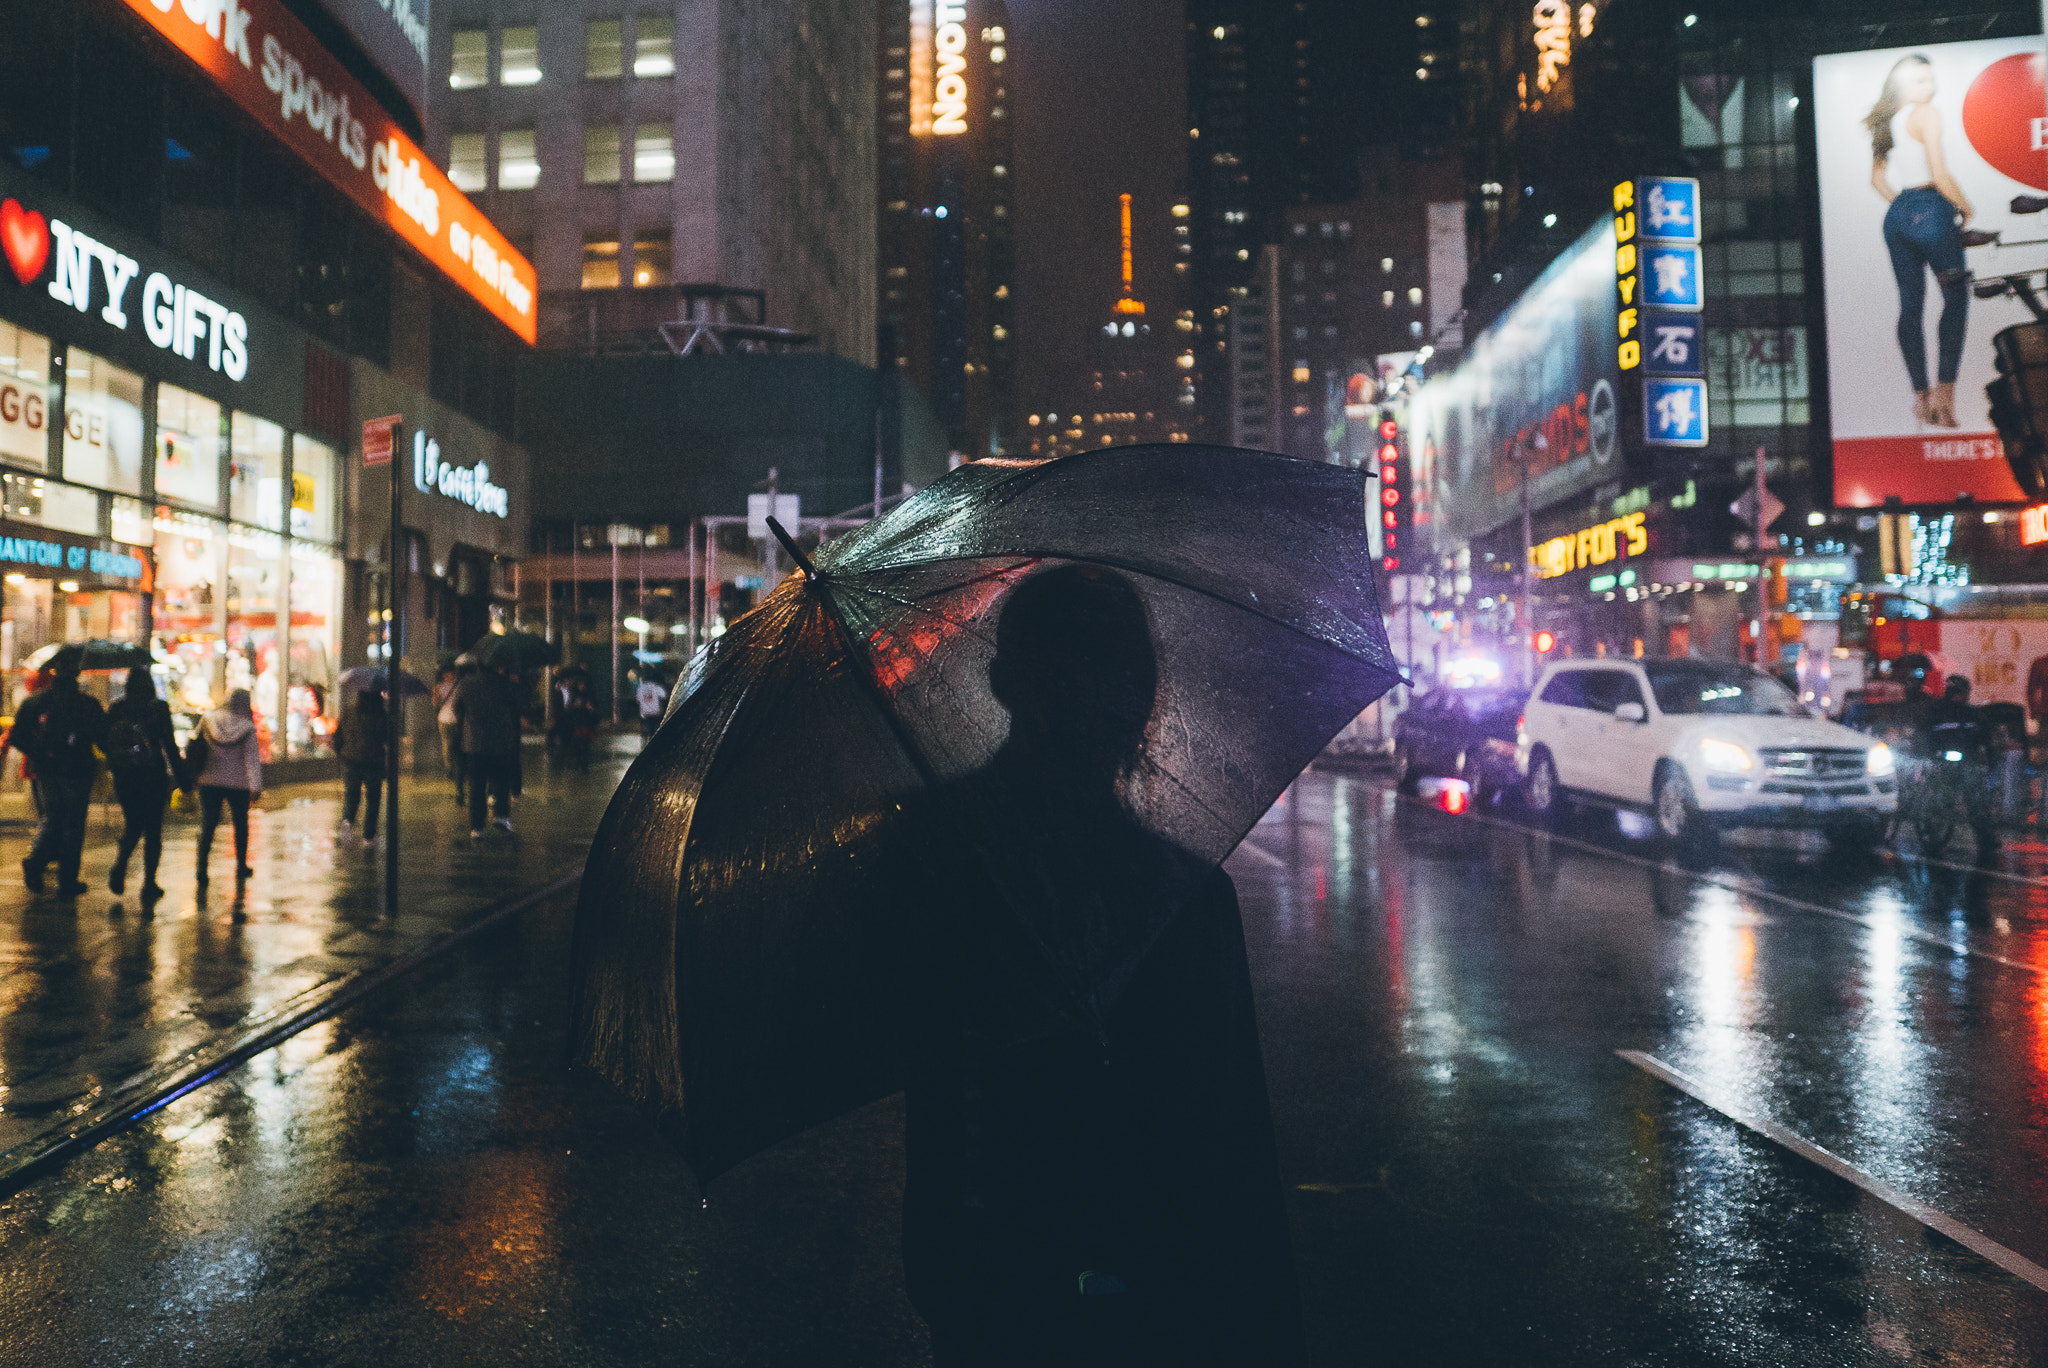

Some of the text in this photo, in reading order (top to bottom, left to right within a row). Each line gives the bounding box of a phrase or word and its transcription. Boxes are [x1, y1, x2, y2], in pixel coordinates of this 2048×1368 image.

[261, 33, 366, 168] sports
[931, 0, 968, 135] NOVOT
[48, 218, 248, 383] NY GIFTS
[67, 546, 87, 570] OF
